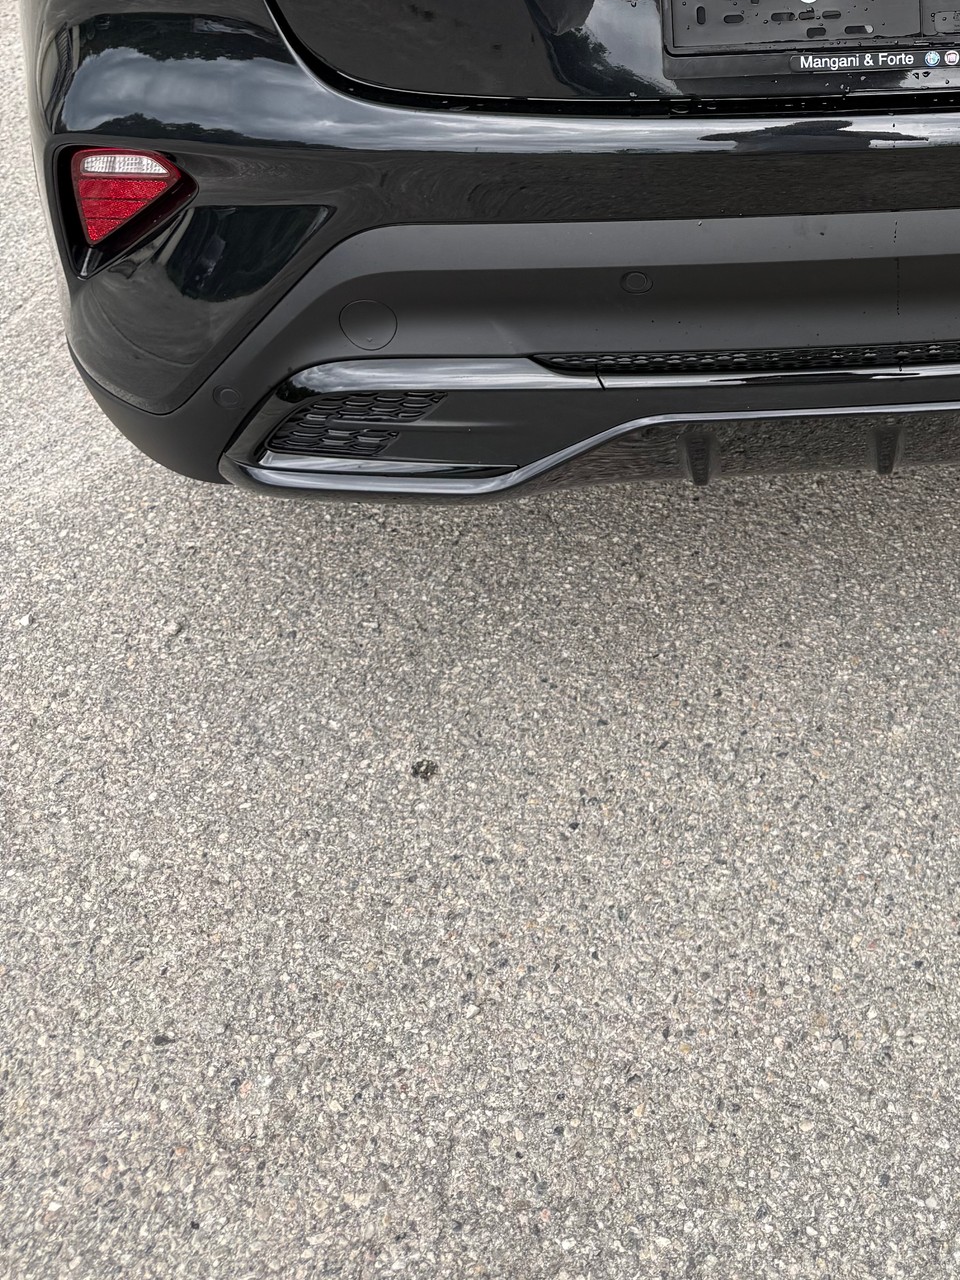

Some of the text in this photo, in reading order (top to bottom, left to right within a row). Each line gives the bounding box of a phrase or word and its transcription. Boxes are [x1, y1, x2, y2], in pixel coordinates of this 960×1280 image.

[800, 54, 859, 70] Mangani
[864, 53, 874, 66] &
[878, 53, 914, 66] Forte
